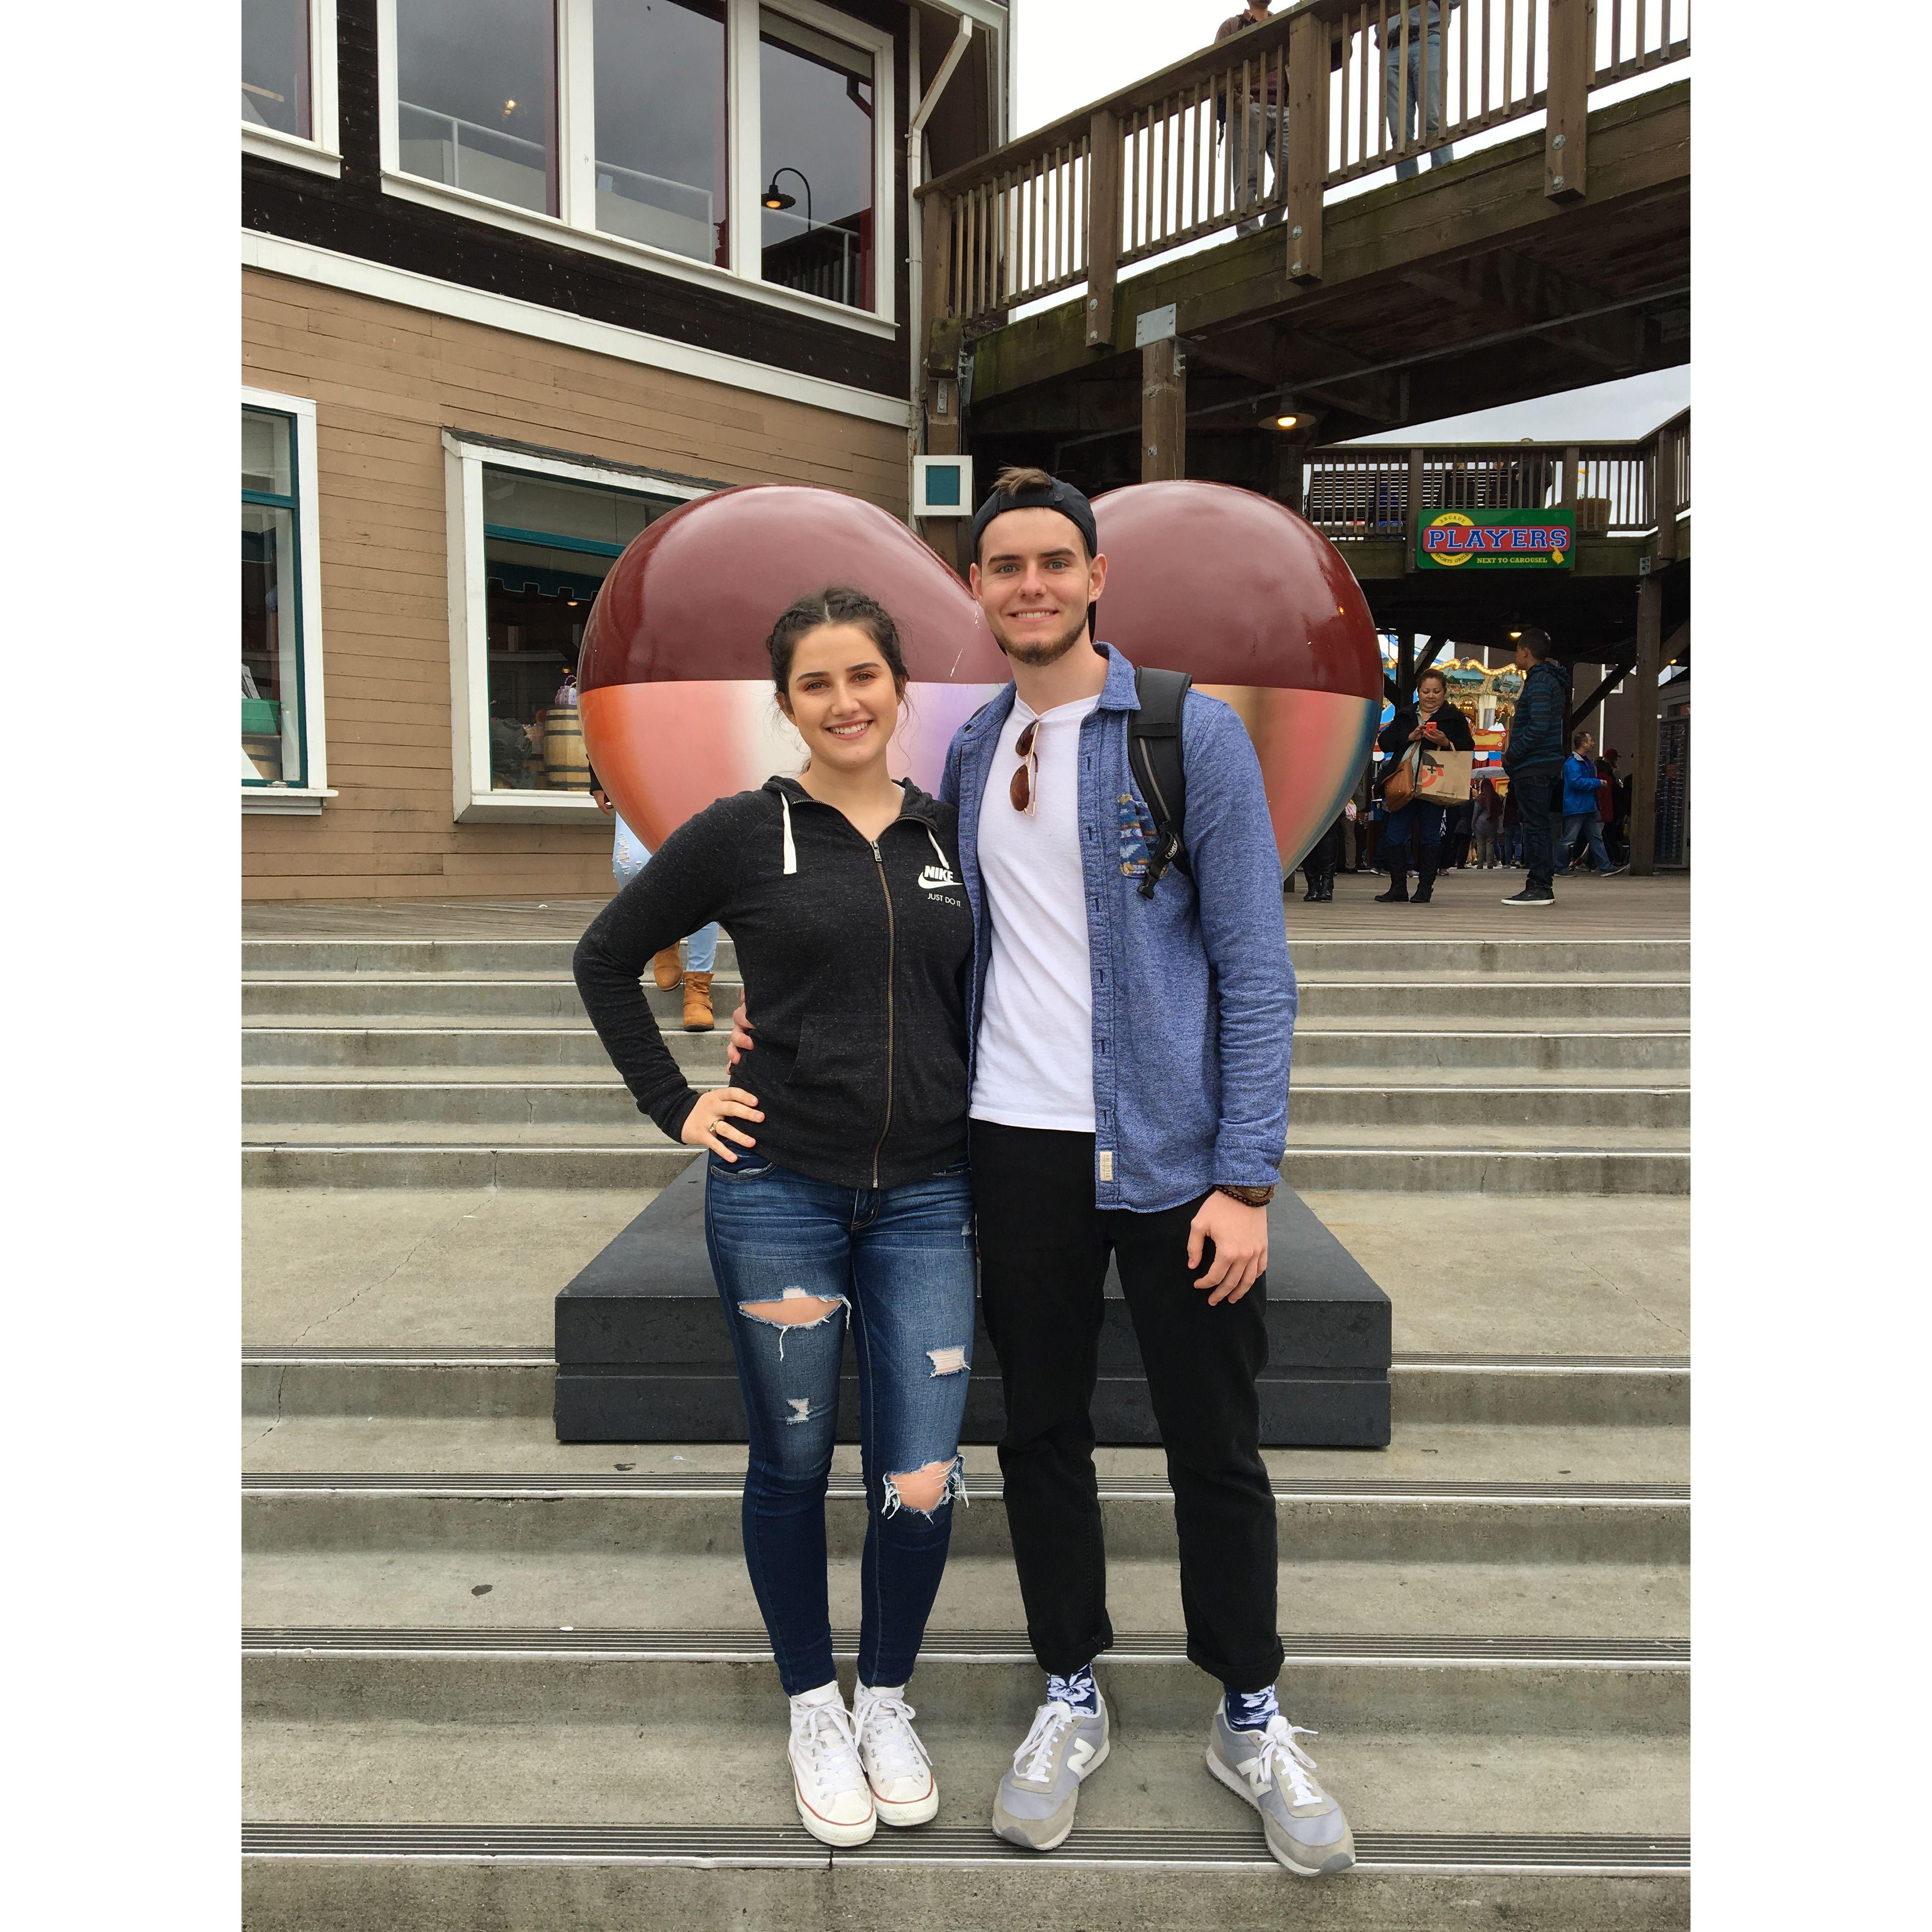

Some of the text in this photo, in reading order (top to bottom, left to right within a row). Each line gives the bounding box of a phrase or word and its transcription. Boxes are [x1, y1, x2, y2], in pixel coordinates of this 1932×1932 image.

[1428, 529, 1566, 548] PLAYERS
[924, 865, 954, 882] NIKE
[928, 893, 943, 901] JUST
[945, 897, 955, 905] DO
